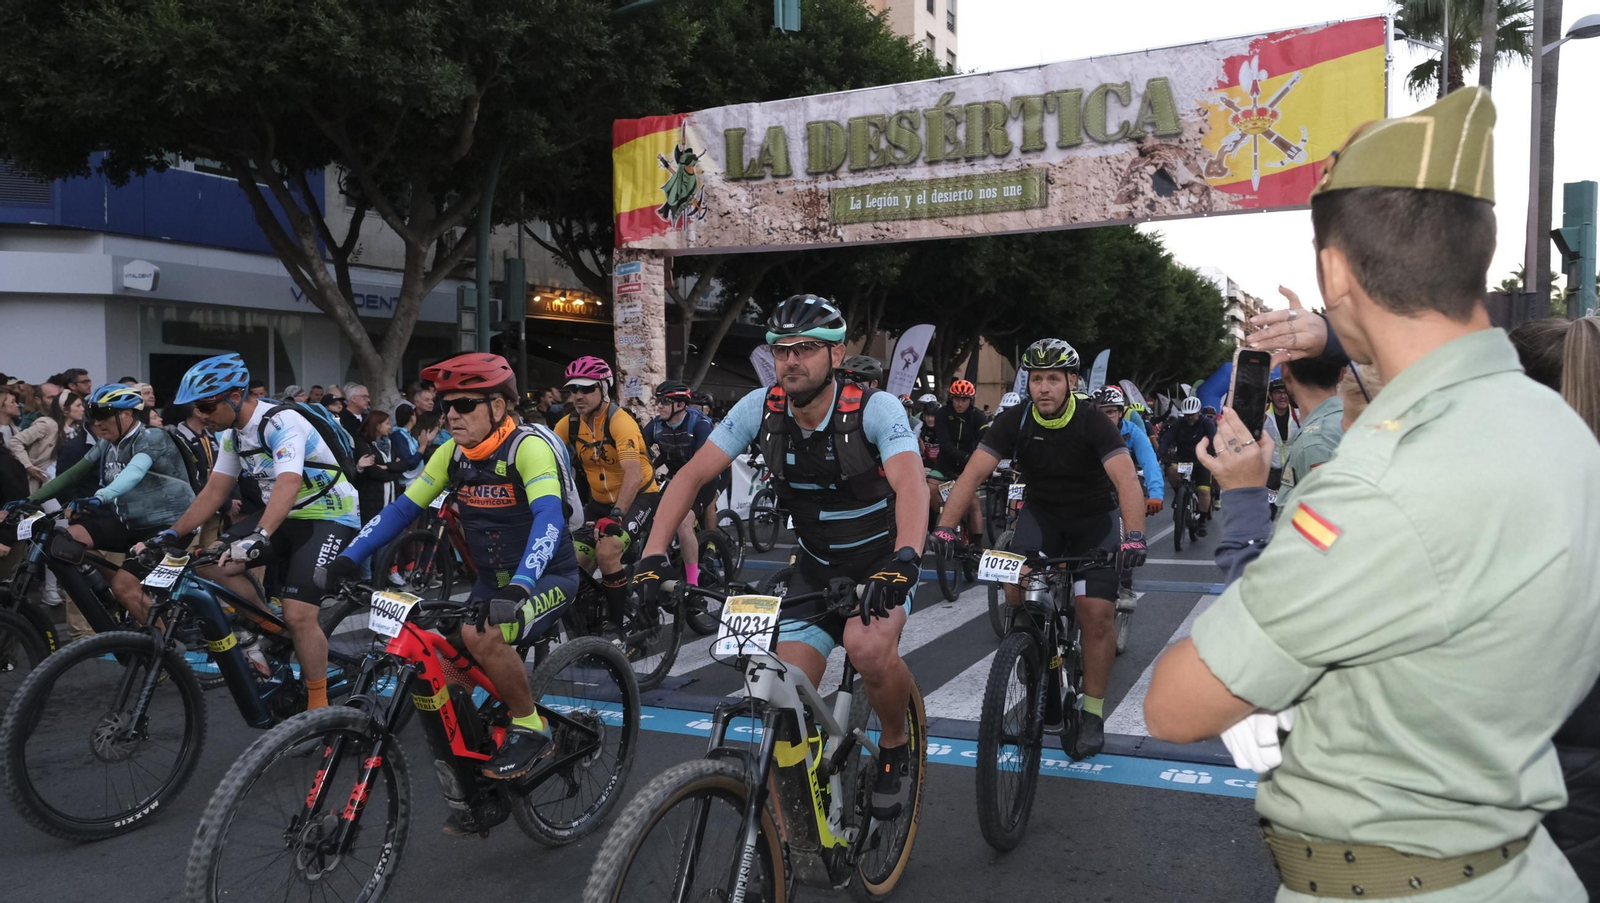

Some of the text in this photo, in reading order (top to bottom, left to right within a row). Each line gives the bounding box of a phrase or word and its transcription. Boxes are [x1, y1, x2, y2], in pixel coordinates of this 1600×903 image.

[724, 76, 1183, 180] LA DESÉRTICA
[849, 184, 1023, 210] La Legión y el desierto nos une
[619, 335, 640, 345] BBVA
[985, 556, 1020, 572] 10129
[373, 597, 406, 622] 10090
[726, 615, 770, 637] 10231
[114, 800, 159, 828] MAXXIS
[732, 844, 756, 903] ROCKSHOX
